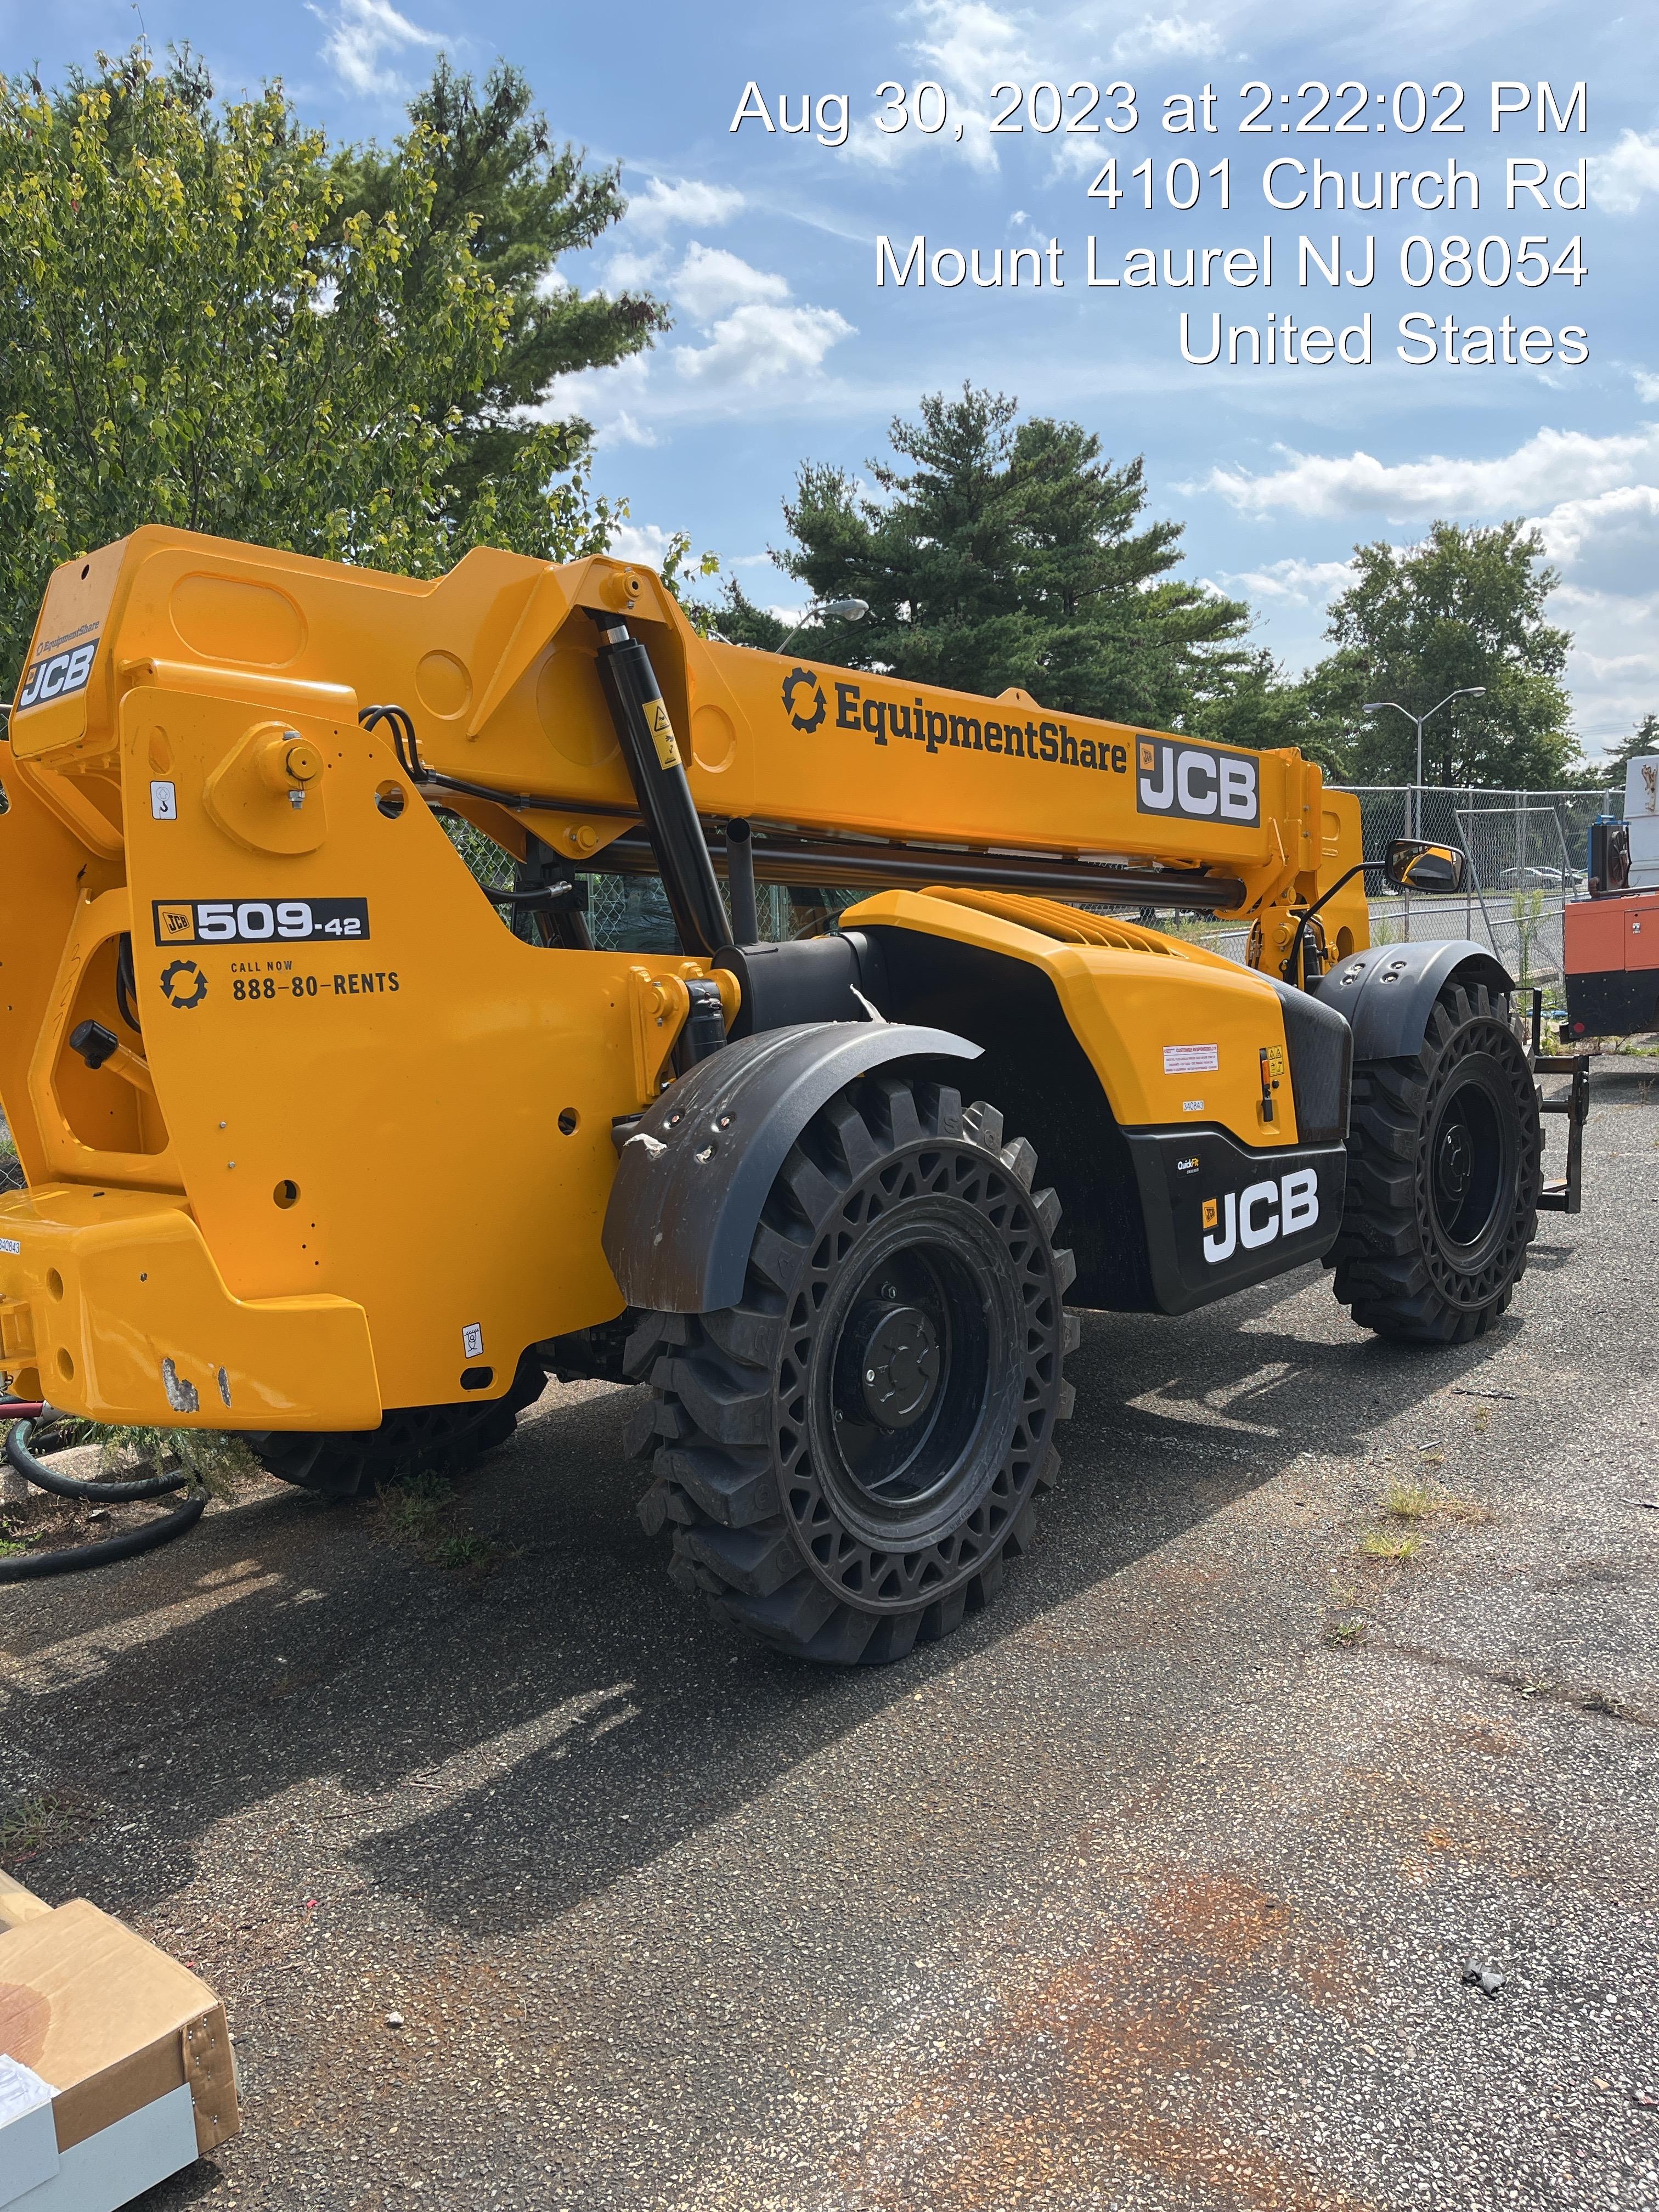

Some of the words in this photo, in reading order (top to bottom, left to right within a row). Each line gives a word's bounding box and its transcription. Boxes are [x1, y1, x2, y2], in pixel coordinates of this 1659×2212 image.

[43, 621, 100, 651] EquipmentShare
[21, 645, 94, 706] JCB
[834, 682, 1126, 774] EquipmentShare
[1140, 747, 1257, 820] JCB
[167, 915, 188, 931] JCB
[198, 902, 362, 940] 509-42
[231, 963, 261, 973] CALL
[267, 961, 292, 971] NOW
[234, 972, 399, 1000] 888-80-RENTS
[1183, 1101, 1204, 1110] 340843
[1177, 1158, 1199, 1170] QuickFit
[1203, 1168, 1319, 1263] JCB
